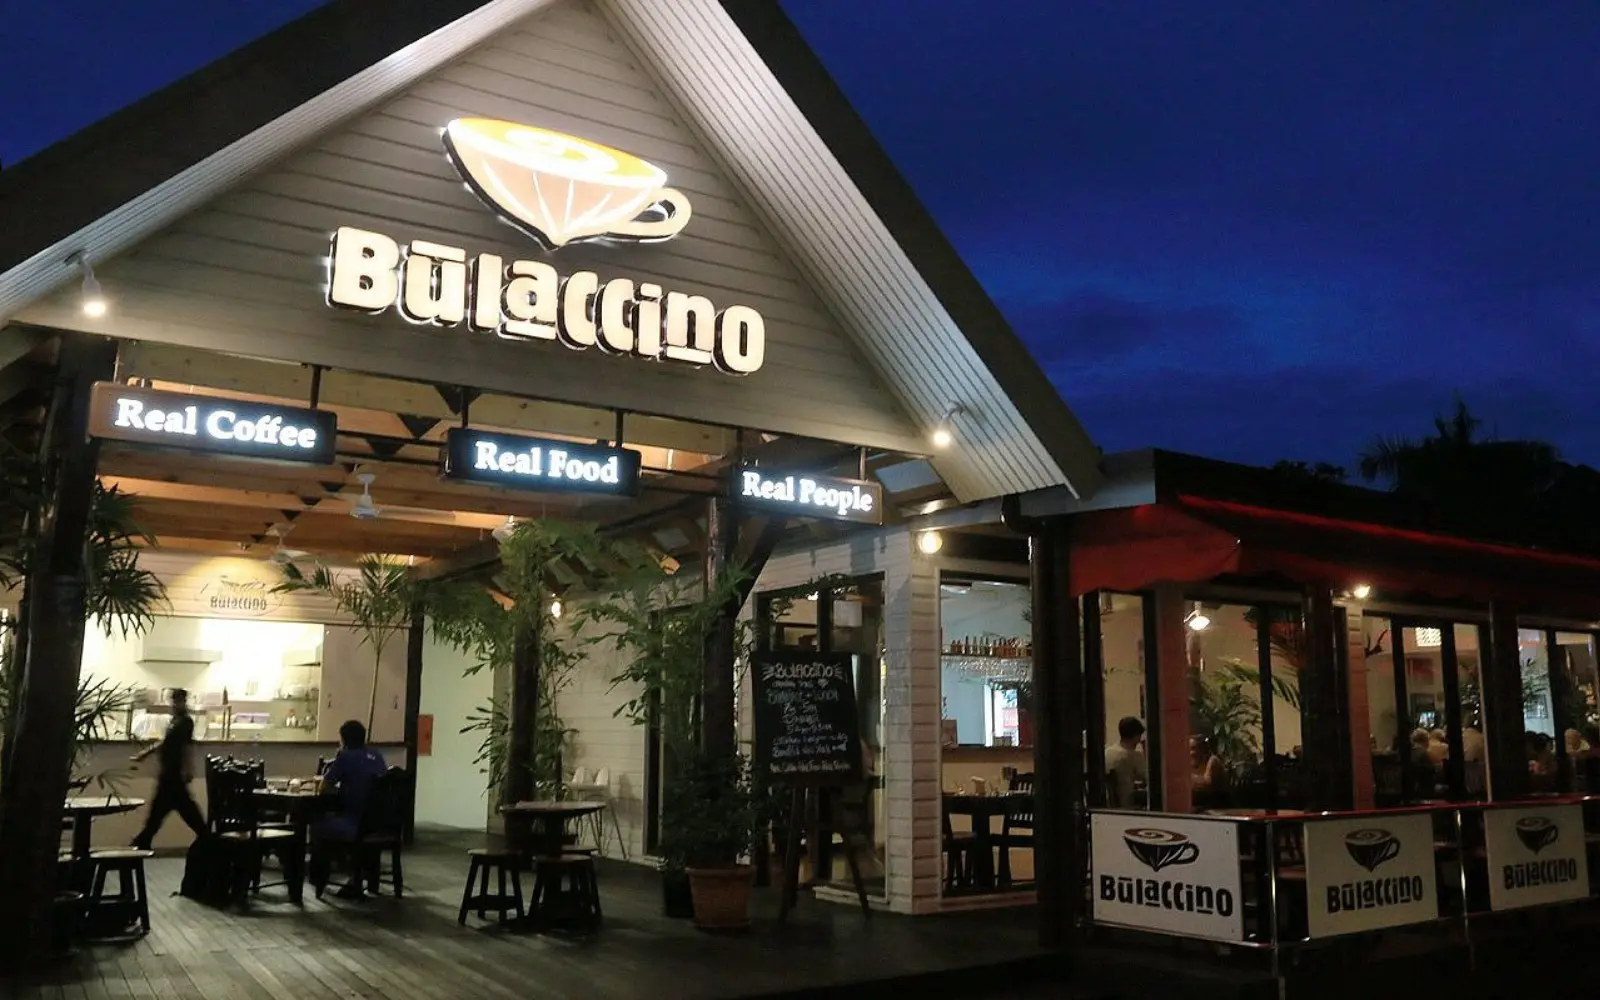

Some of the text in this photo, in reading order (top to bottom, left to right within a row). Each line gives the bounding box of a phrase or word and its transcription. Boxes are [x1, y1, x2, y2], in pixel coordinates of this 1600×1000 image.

[115, 398, 317, 448] Real Coffee
[474, 441, 619, 483] Real Food
[742, 471, 873, 516] Real People
